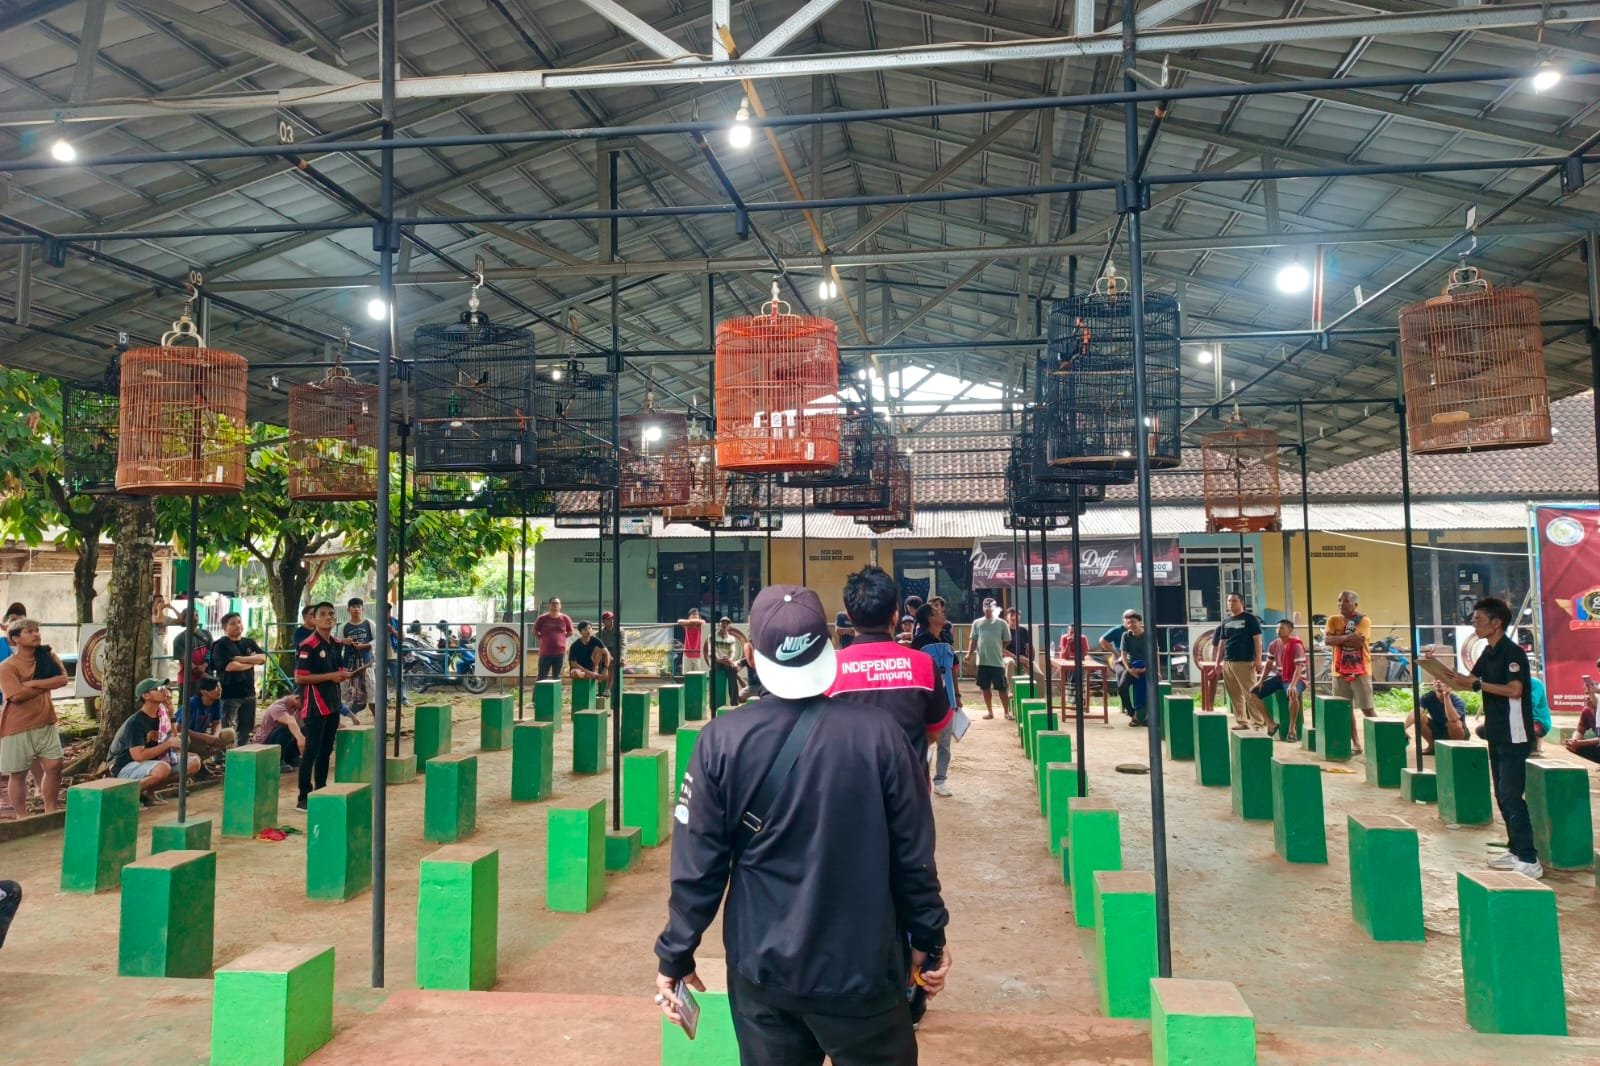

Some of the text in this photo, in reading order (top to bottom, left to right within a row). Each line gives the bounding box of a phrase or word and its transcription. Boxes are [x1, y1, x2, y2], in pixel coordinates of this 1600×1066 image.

[280, 121, 293, 143] 03
[191, 270, 203, 286] 09
[1080, 549, 1118, 577] Duff
[842, 657, 911, 674] INDEPENDEN
[866, 670, 913, 682] Lampung
